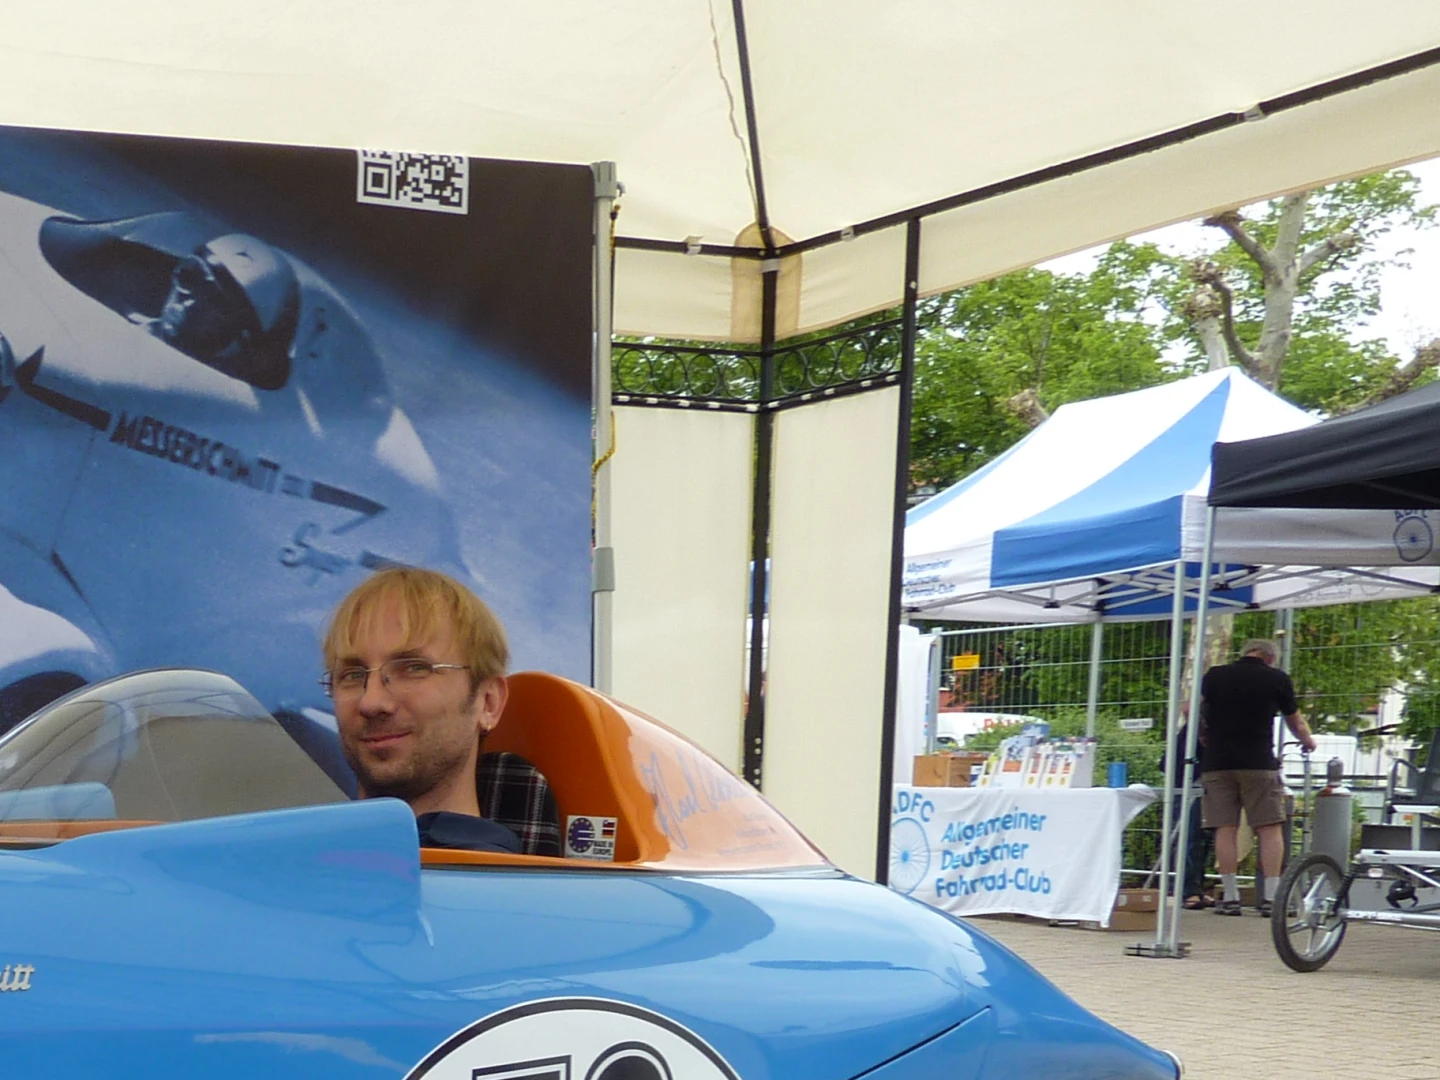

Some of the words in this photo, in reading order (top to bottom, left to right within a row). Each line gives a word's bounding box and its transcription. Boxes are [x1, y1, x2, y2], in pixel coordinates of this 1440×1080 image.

[893, 790, 935, 823] DFC
[941, 806, 1047, 846] Allgemeiner
[940, 838, 1029, 871] Deutscher
[934, 867, 1051, 898] Fahrrad-Club
